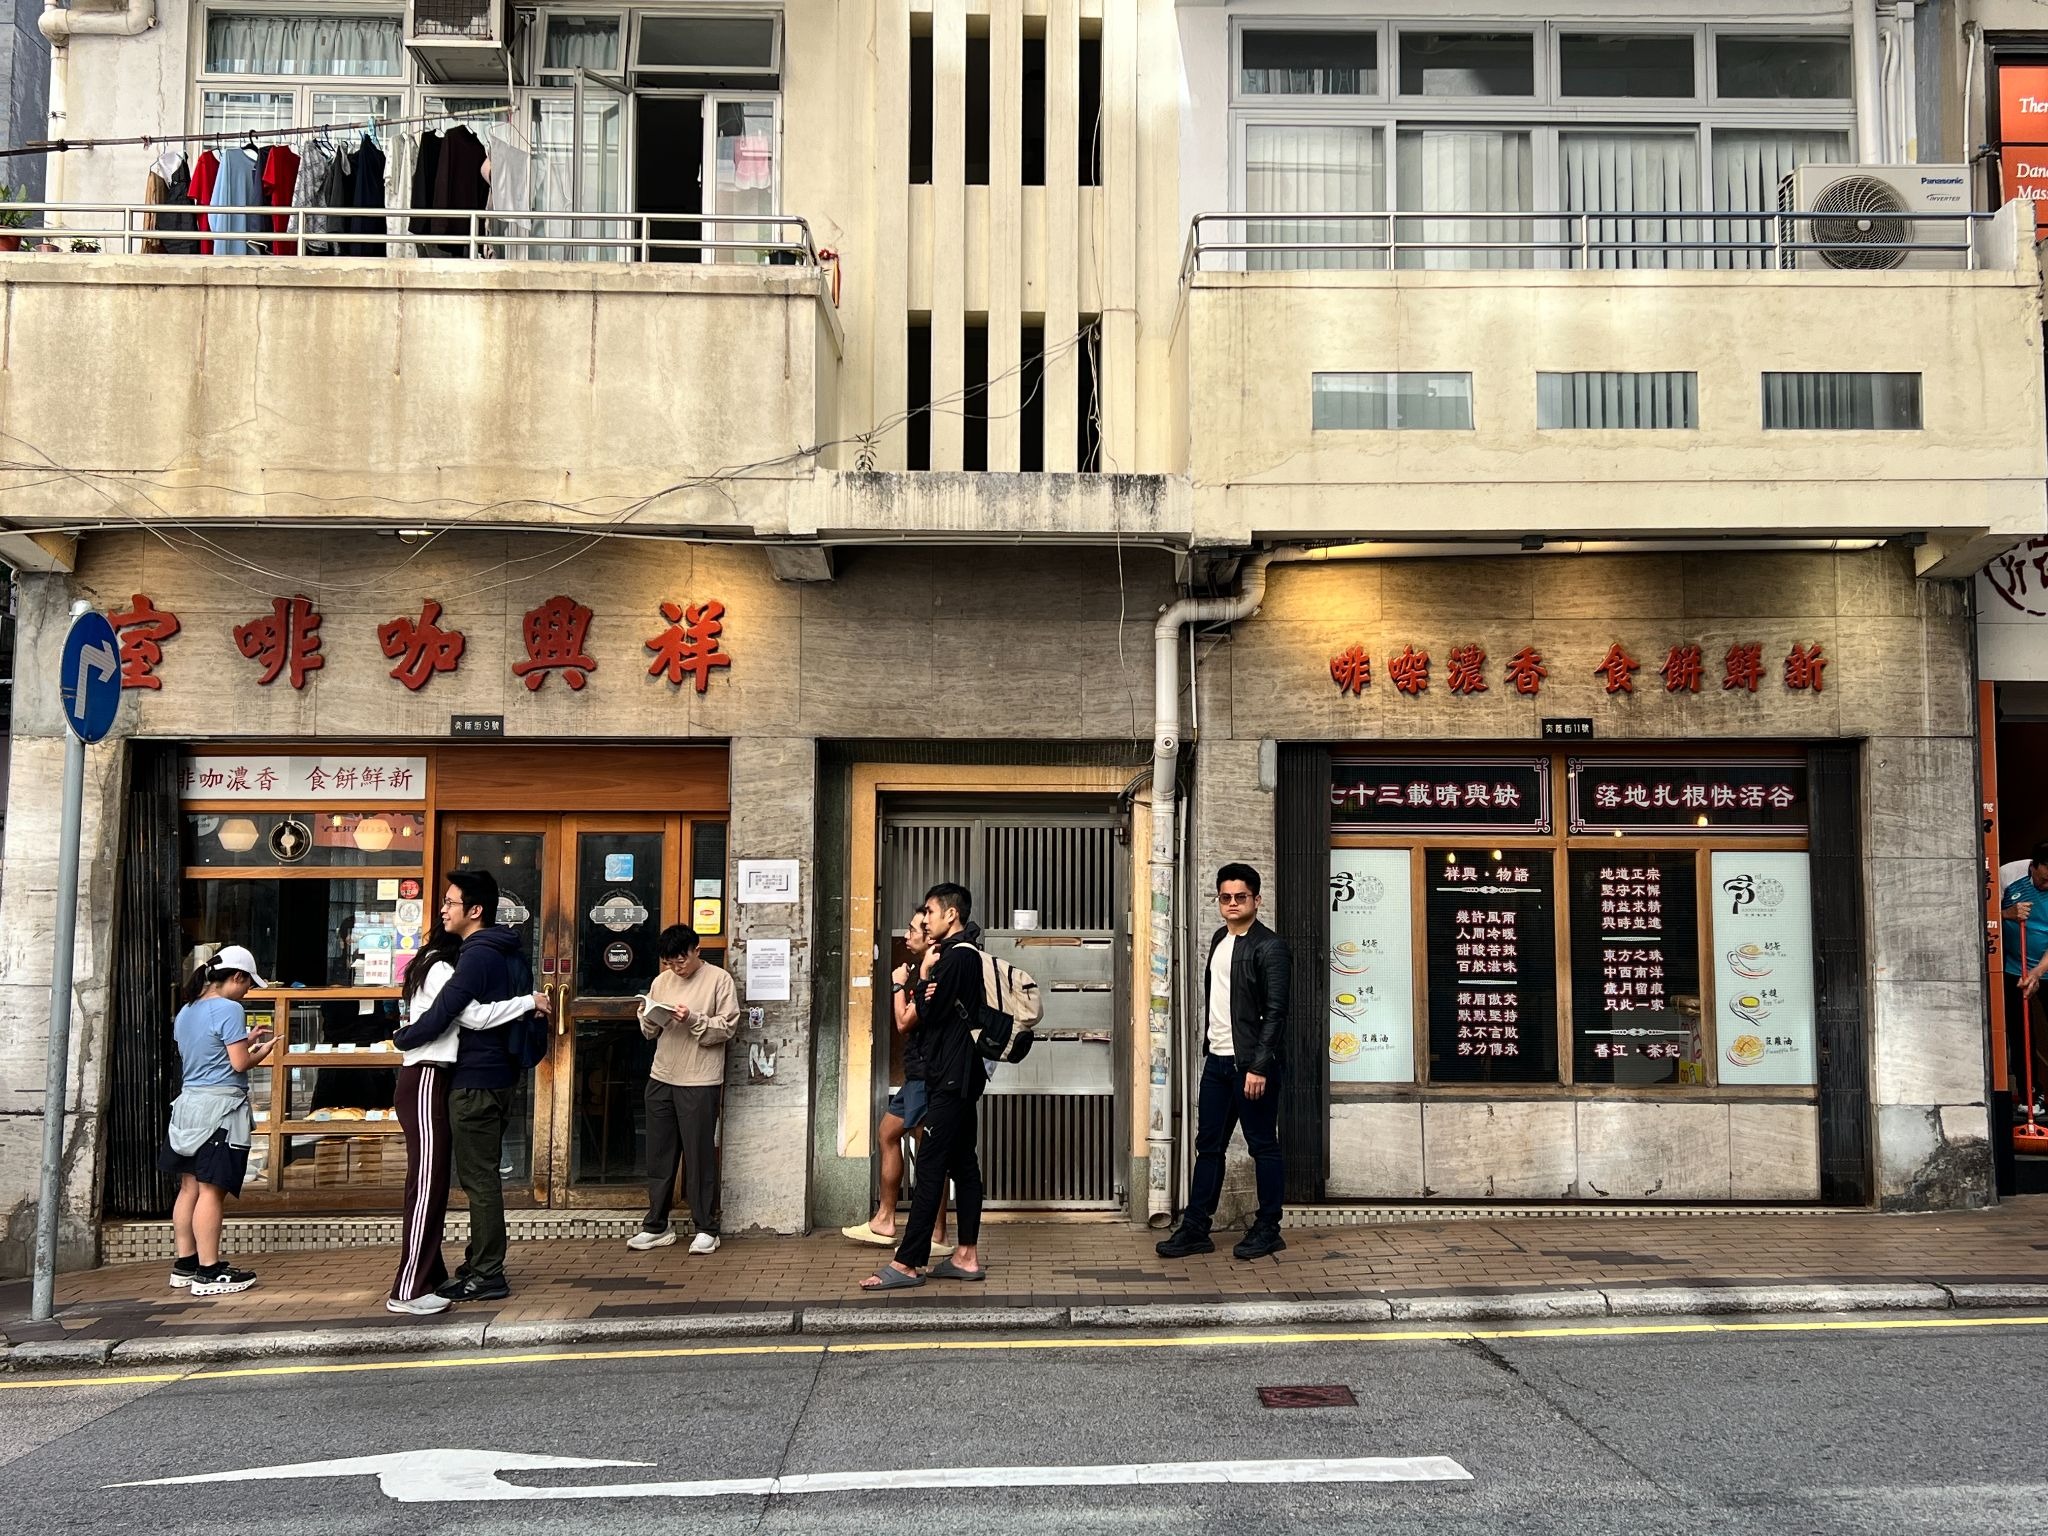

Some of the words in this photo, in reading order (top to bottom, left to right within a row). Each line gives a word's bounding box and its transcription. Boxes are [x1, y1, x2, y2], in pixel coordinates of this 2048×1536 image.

[1921, 177, 1964, 185] Panasonic
[1595, 784, 1795, 808] 落地扎根快活谷
[1601, 868, 1661, 882] 地道正宗
[1601, 884, 1662, 898] 堅守不懈
[1601, 900, 1662, 914] 精益求精
[1456, 911, 1517, 925] 幾許風雨
[1602, 916, 1662, 930] 與時並進
[1456, 927, 1517, 941] 人間冷暖
[1456, 943, 1517, 957] 甜酸苦辣
[1603, 949, 1664, 963] 東方之珠
[1456, 960, 1518, 974] 百般滋味
[1604, 965, 1664, 979] 中西南洋
[1604, 981, 1665, 996] 歲月留痕
[1604, 998, 1665, 1012] 只此一家
[1458, 1025, 1519, 1040] 永不言敗
[1458, 1042, 1519, 1056] 努力傳承
